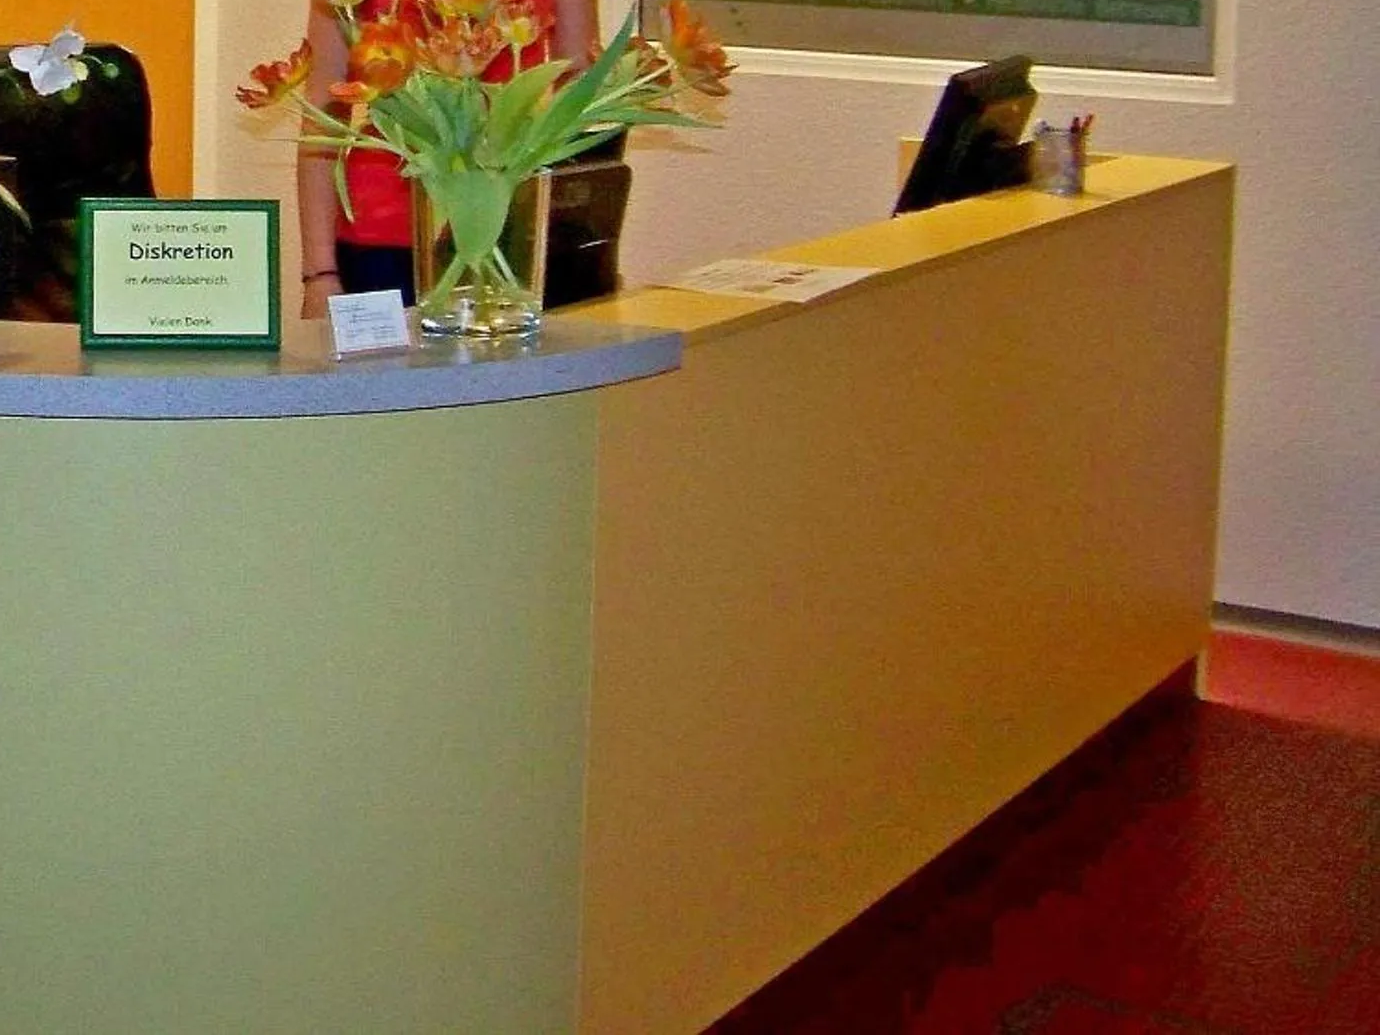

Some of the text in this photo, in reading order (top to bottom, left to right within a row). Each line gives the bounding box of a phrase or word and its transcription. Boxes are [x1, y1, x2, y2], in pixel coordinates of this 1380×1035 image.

[131, 223, 151, 234] Wir
[155, 223, 189, 234] bitten
[129, 241, 234, 260] Diskretion
[185, 316, 213, 327] Dank
